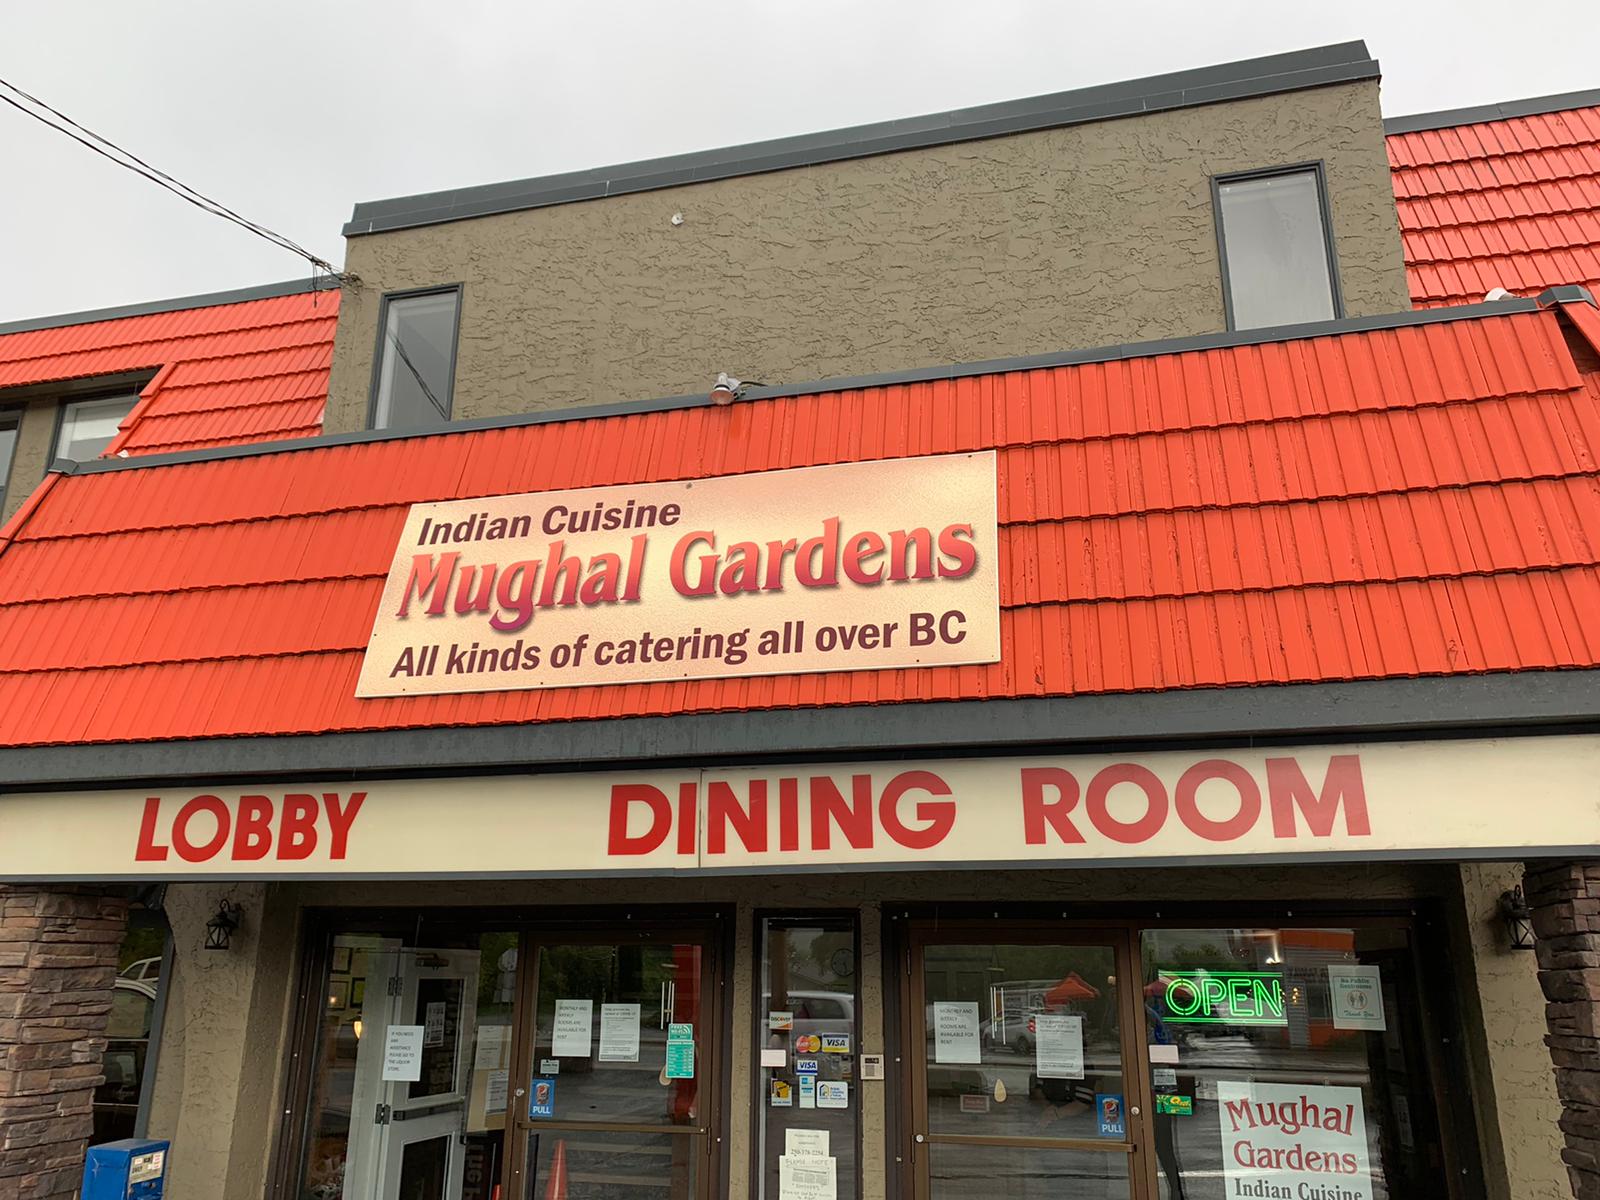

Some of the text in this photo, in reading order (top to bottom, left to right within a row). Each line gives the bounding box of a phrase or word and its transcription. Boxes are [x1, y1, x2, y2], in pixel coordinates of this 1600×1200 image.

[417, 503, 681, 546] Indian Cuisine
[395, 516, 978, 632] Mughal Gardens
[390, 609, 968, 679] All kinds of catering all over BC
[134, 753, 1372, 863] LOBBY DINING ROOM
[1165, 978, 1283, 1017] OPEN
[826, 1039, 846, 1047] VISA
[532, 1105, 551, 1114] PULL
[1101, 1123, 1124, 1133] PULL
[1224, 1095, 1354, 1136] Mughal
[1233, 1140, 1358, 1175] Gardens
[1234, 1178, 1363, 1200] Indian Cuisine
